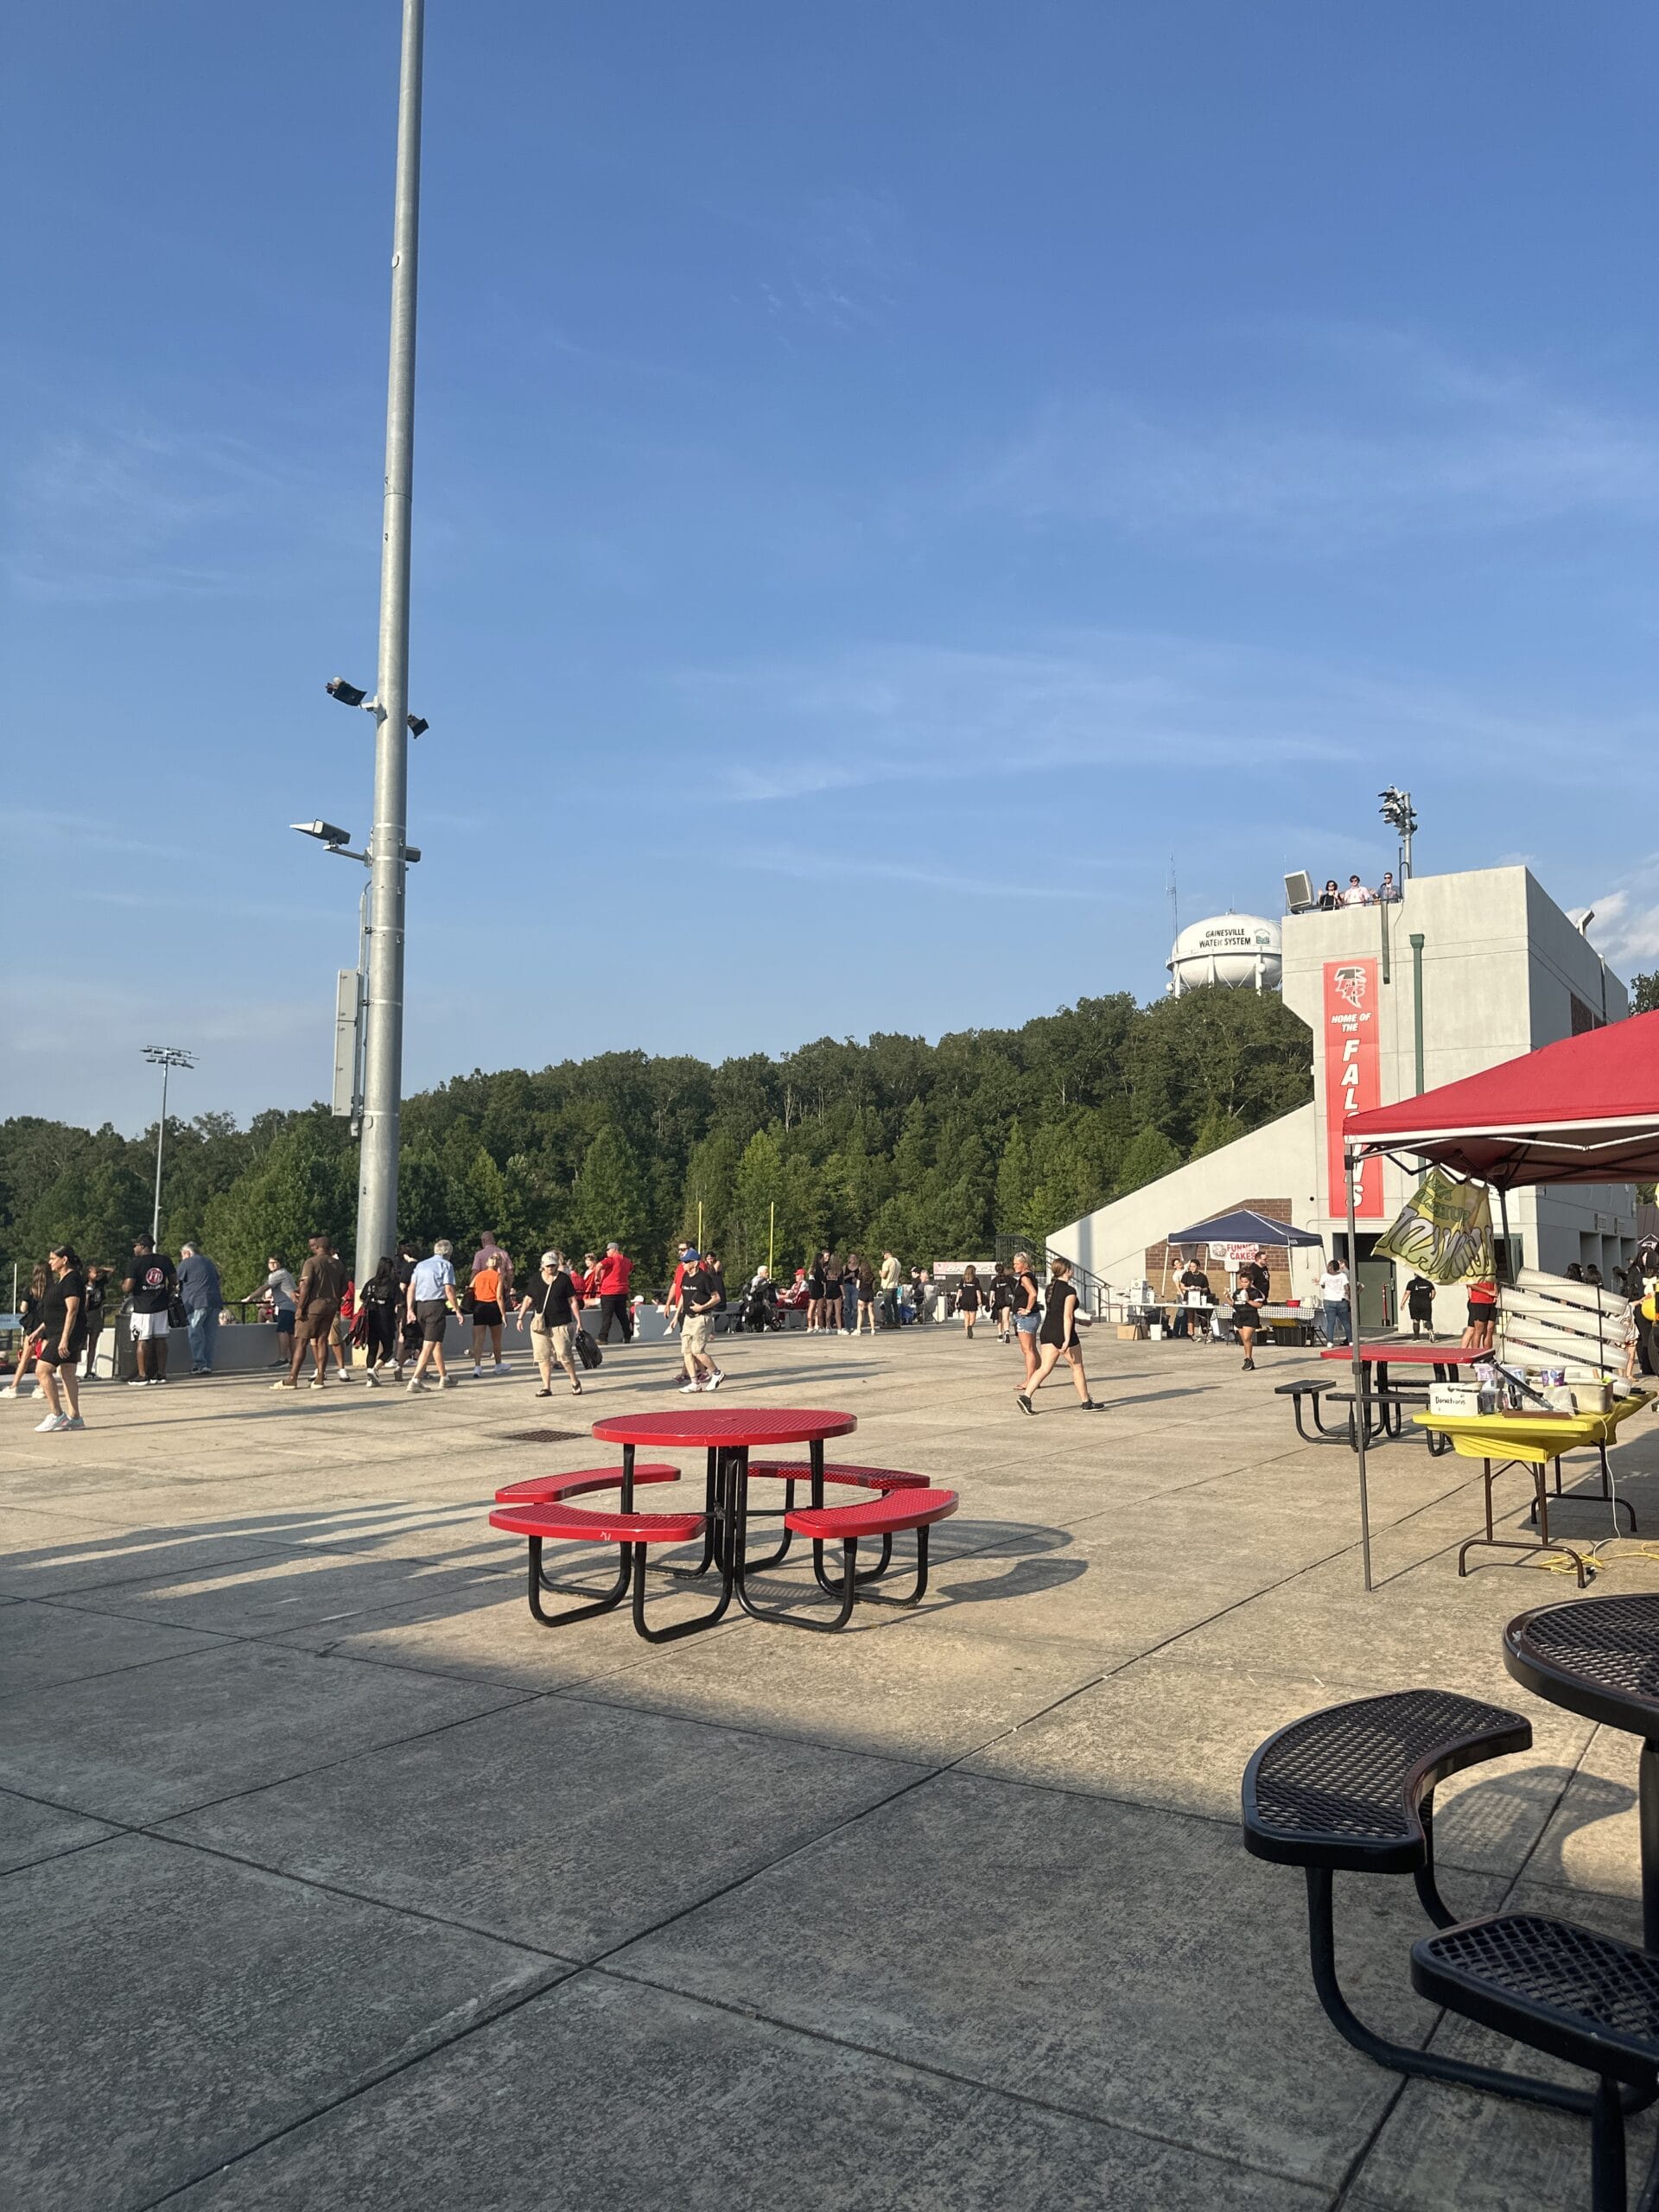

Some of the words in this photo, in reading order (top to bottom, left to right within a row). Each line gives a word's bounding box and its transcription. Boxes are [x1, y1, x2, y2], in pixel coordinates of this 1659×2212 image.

[1205, 928, 1245, 938] GAINESVILLE
[1198, 938, 1223, 949] WATER
[1224, 937, 1251, 946] SYSTEM
[1331, 1013, 1358, 1024] HOME
[1359, 1012, 1372, 1021] OF
[1342, 1022, 1359, 1033] THE
[1227, 1243, 1258, 1253] FUNNEL
[1230, 1252, 1256, 1261] CAKES
